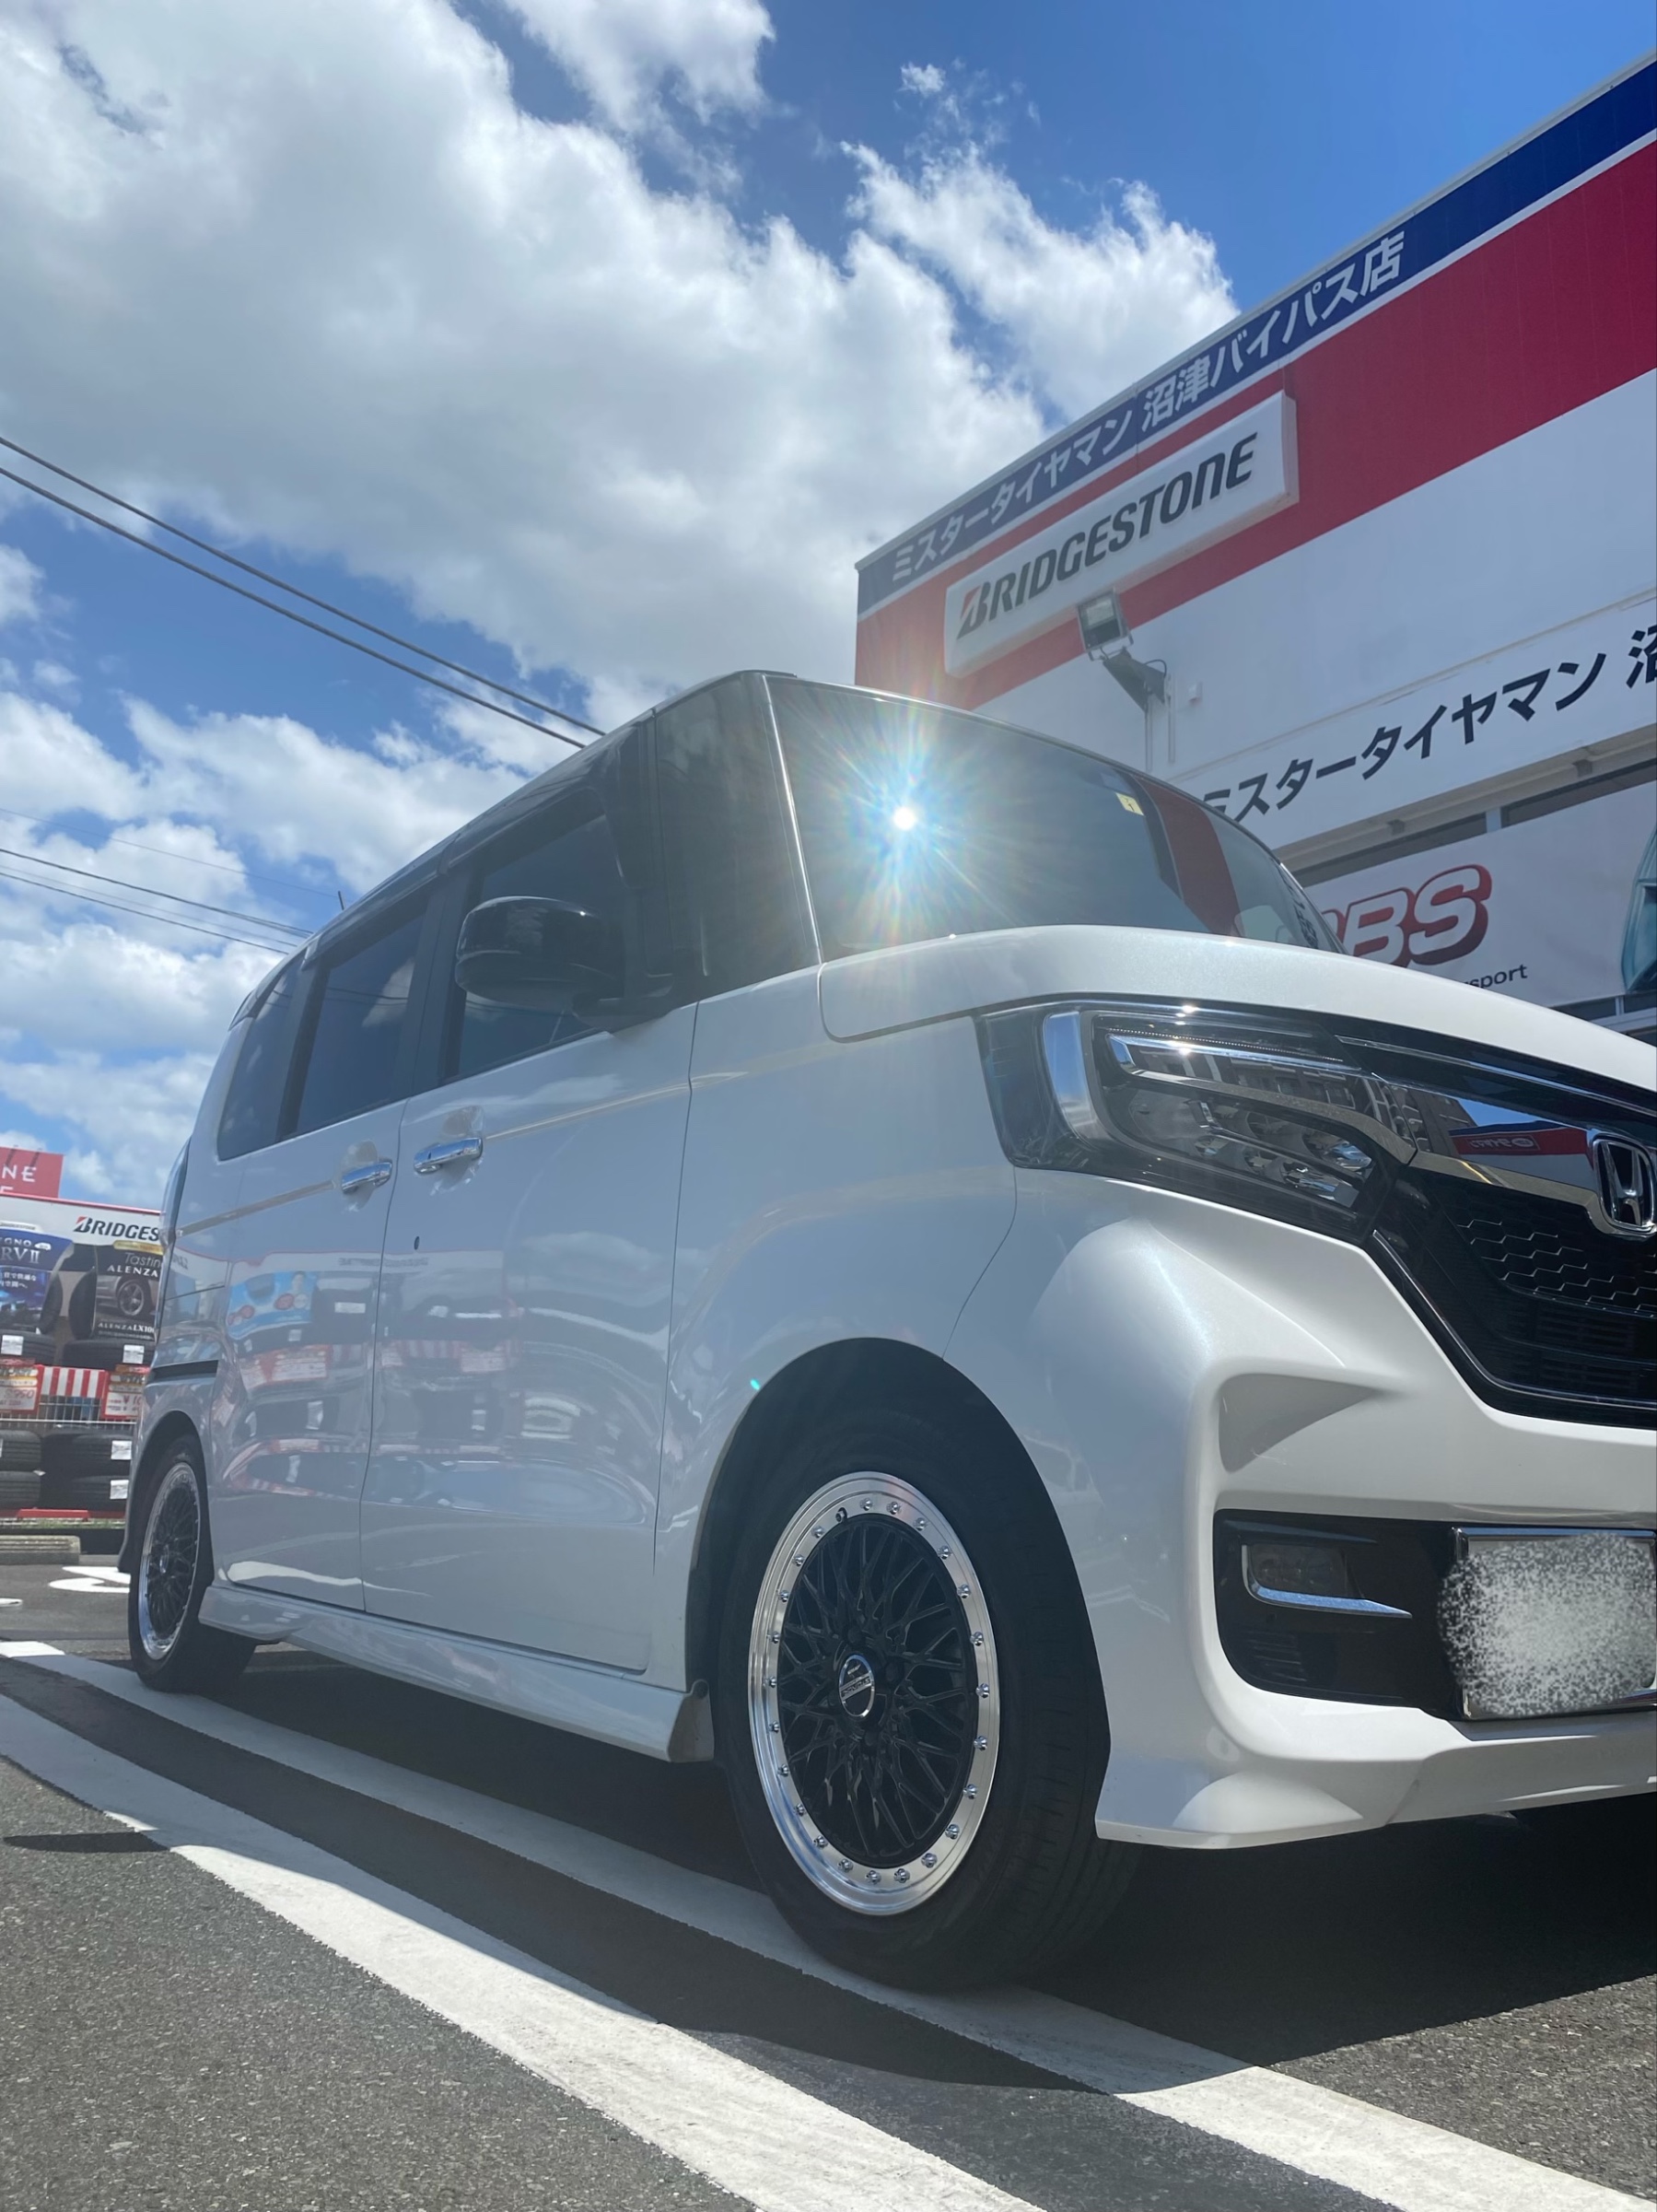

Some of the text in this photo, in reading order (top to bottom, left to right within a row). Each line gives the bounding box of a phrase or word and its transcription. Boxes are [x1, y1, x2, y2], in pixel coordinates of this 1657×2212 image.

[892, 230, 1405, 573] ミスタータイヤマン 沼津バイパス店
[956, 431, 1258, 640] BRIDGESTONE
[73, 1216, 159, 1242] BRIDGES
[107, 1264, 158, 1278] ALENZA
